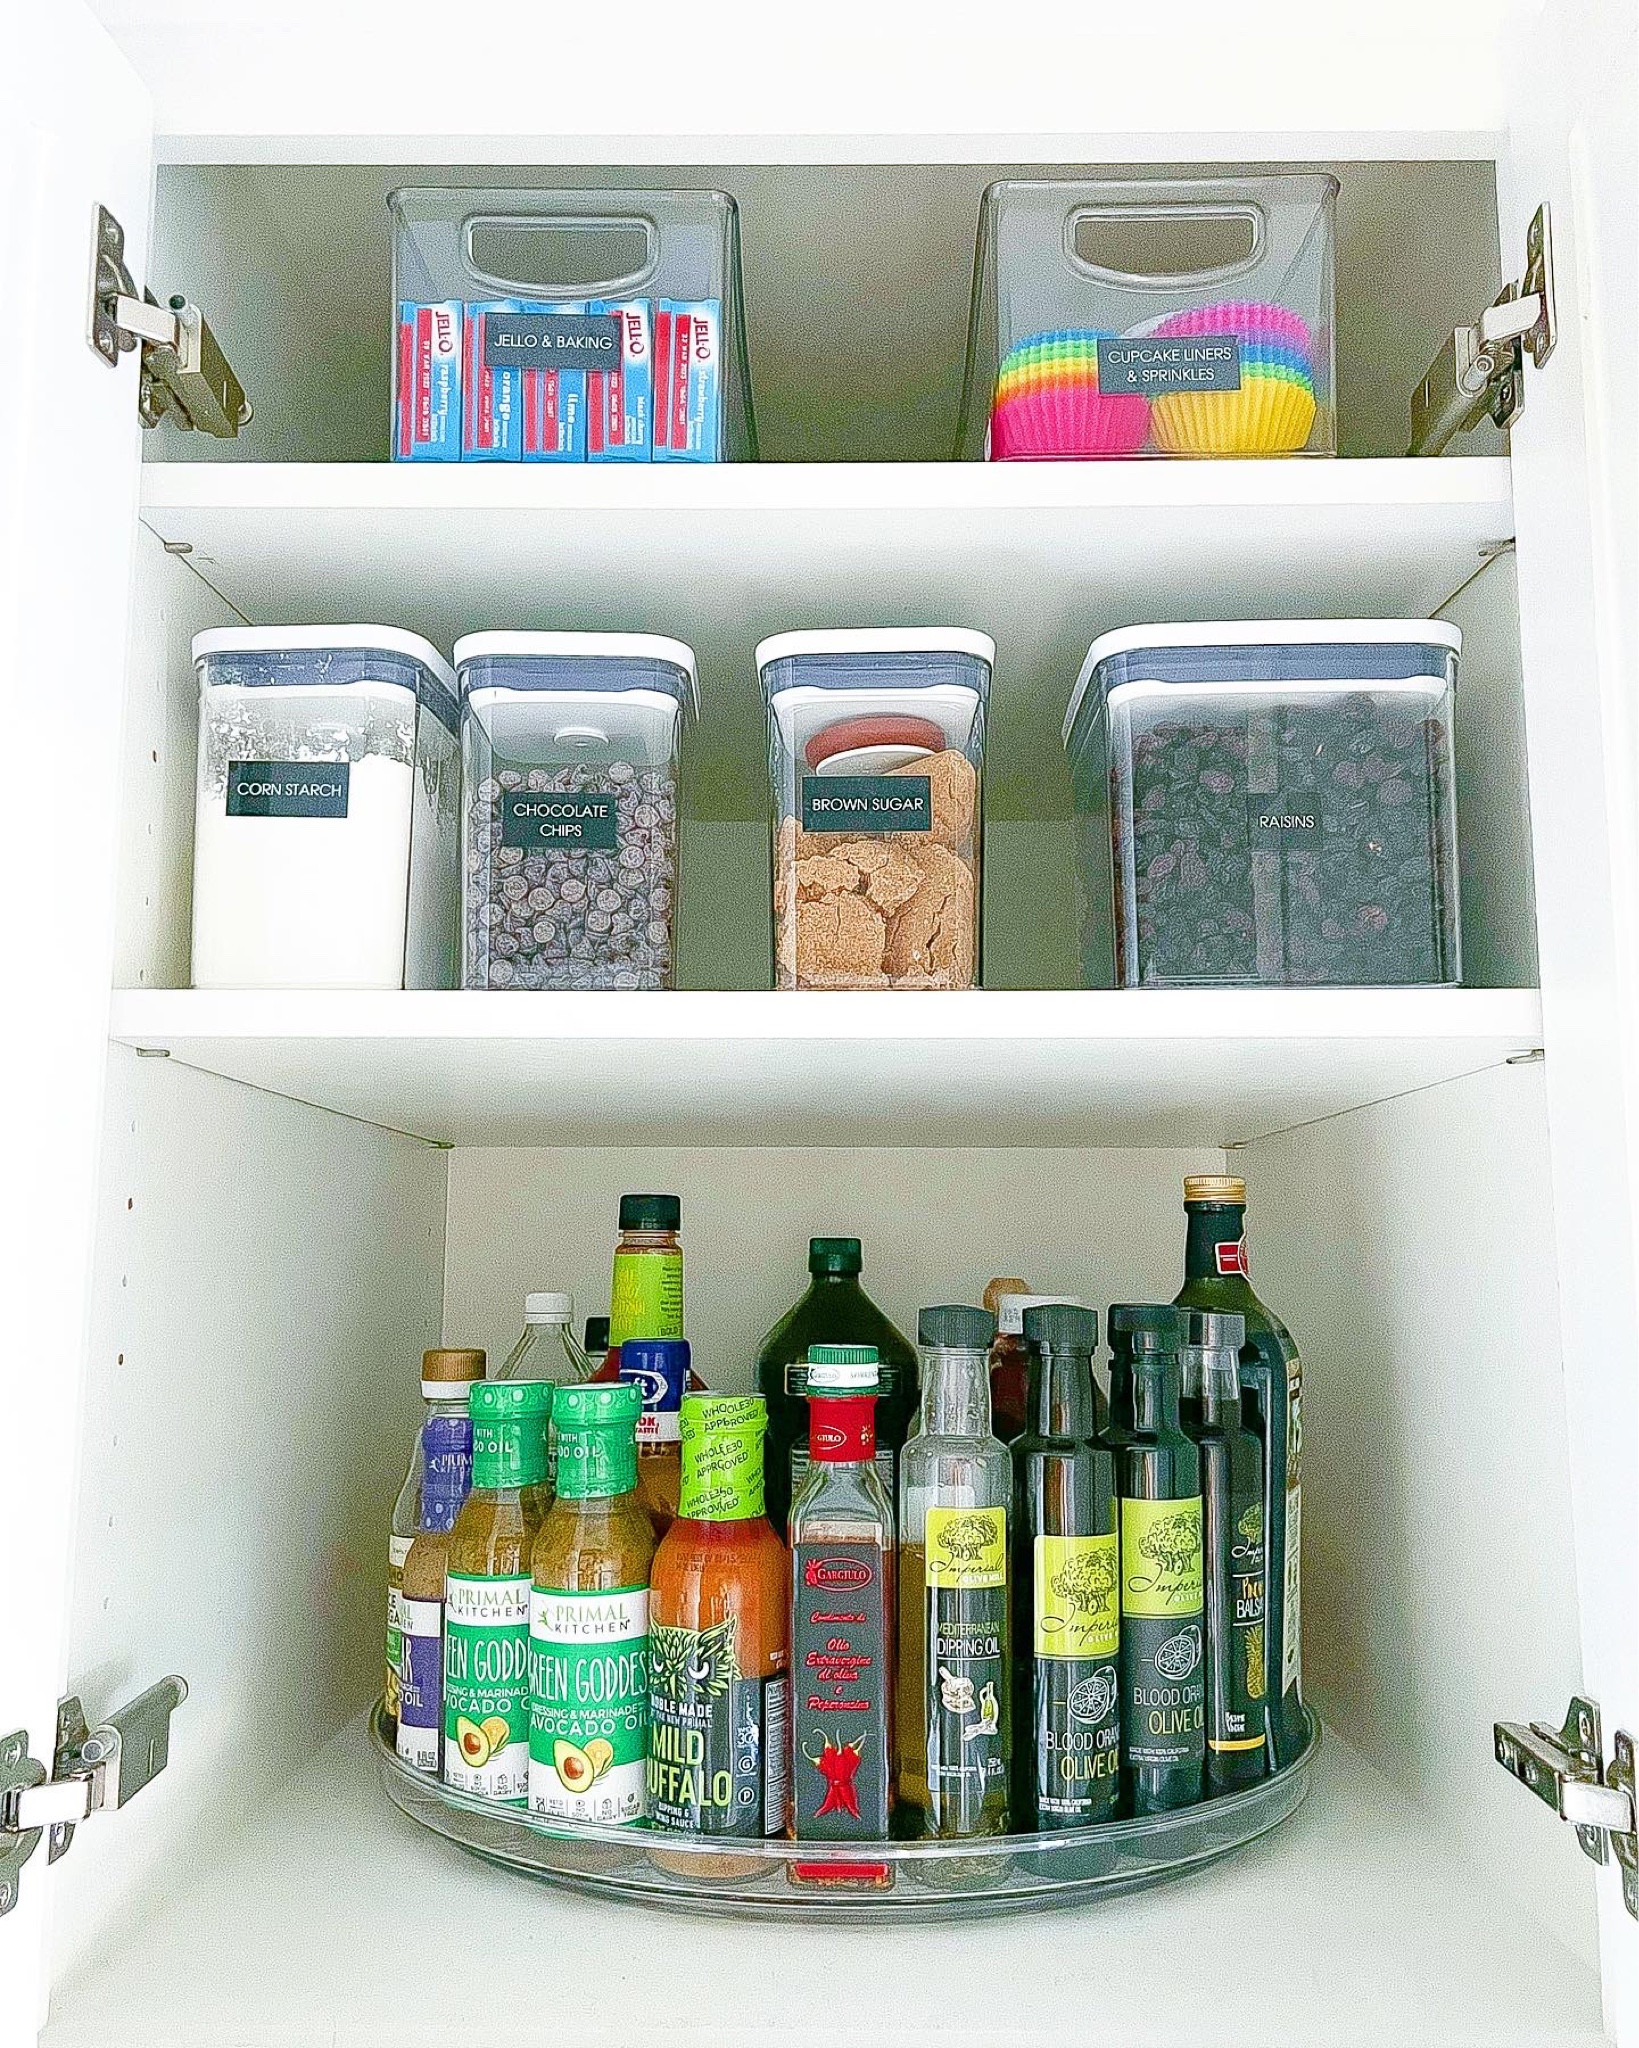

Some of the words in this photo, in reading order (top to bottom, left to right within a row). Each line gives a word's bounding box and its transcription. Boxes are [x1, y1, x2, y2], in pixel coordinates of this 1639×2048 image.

[494, 334, 538, 348] JELLO
[541, 334, 553, 348] &
[556, 335, 613, 350] BAKING
[1107, 350, 1181, 364] CUPCAKE
[1184, 347, 1232, 362] LINERS
[1126, 370, 1138, 382] &
[1141, 368, 1215, 382] SPRINKLES
[237, 782, 282, 796] CORN
[285, 783, 342, 797] STARCH
[513, 803, 609, 818] CHOCOLATE
[812, 798, 868, 811] BROWN
[872, 797, 924, 811] SUGAR
[1259, 815, 1315, 828] RAISINS
[540, 823, 582, 837] CHIPS
[458, 1588, 525, 1605] PRIMAL
[458, 1606, 526, 1618] KITCHEN
[556, 1603, 628, 1621] PRIMAL
[555, 1620, 629, 1635] KITCHEN
[827, 1637, 850, 1651] Olio
[937, 1637, 983, 1656] DIPPING
[985, 1636, 1001, 1655] OIL
[1133, 1686, 1181, 1706] BLOOD
[569, 1710, 577, 1719] &
[580, 1703, 638, 1720] MARINADE
[678, 1702, 713, 1718] MADE
[531, 1712, 616, 1736] AVOCADO
[1148, 1708, 1192, 1735] OLIVE
[653, 1720, 704, 1767] MILD
[1046, 1730, 1094, 1751] BLOOD
[1061, 1752, 1106, 1781] OLIVE
